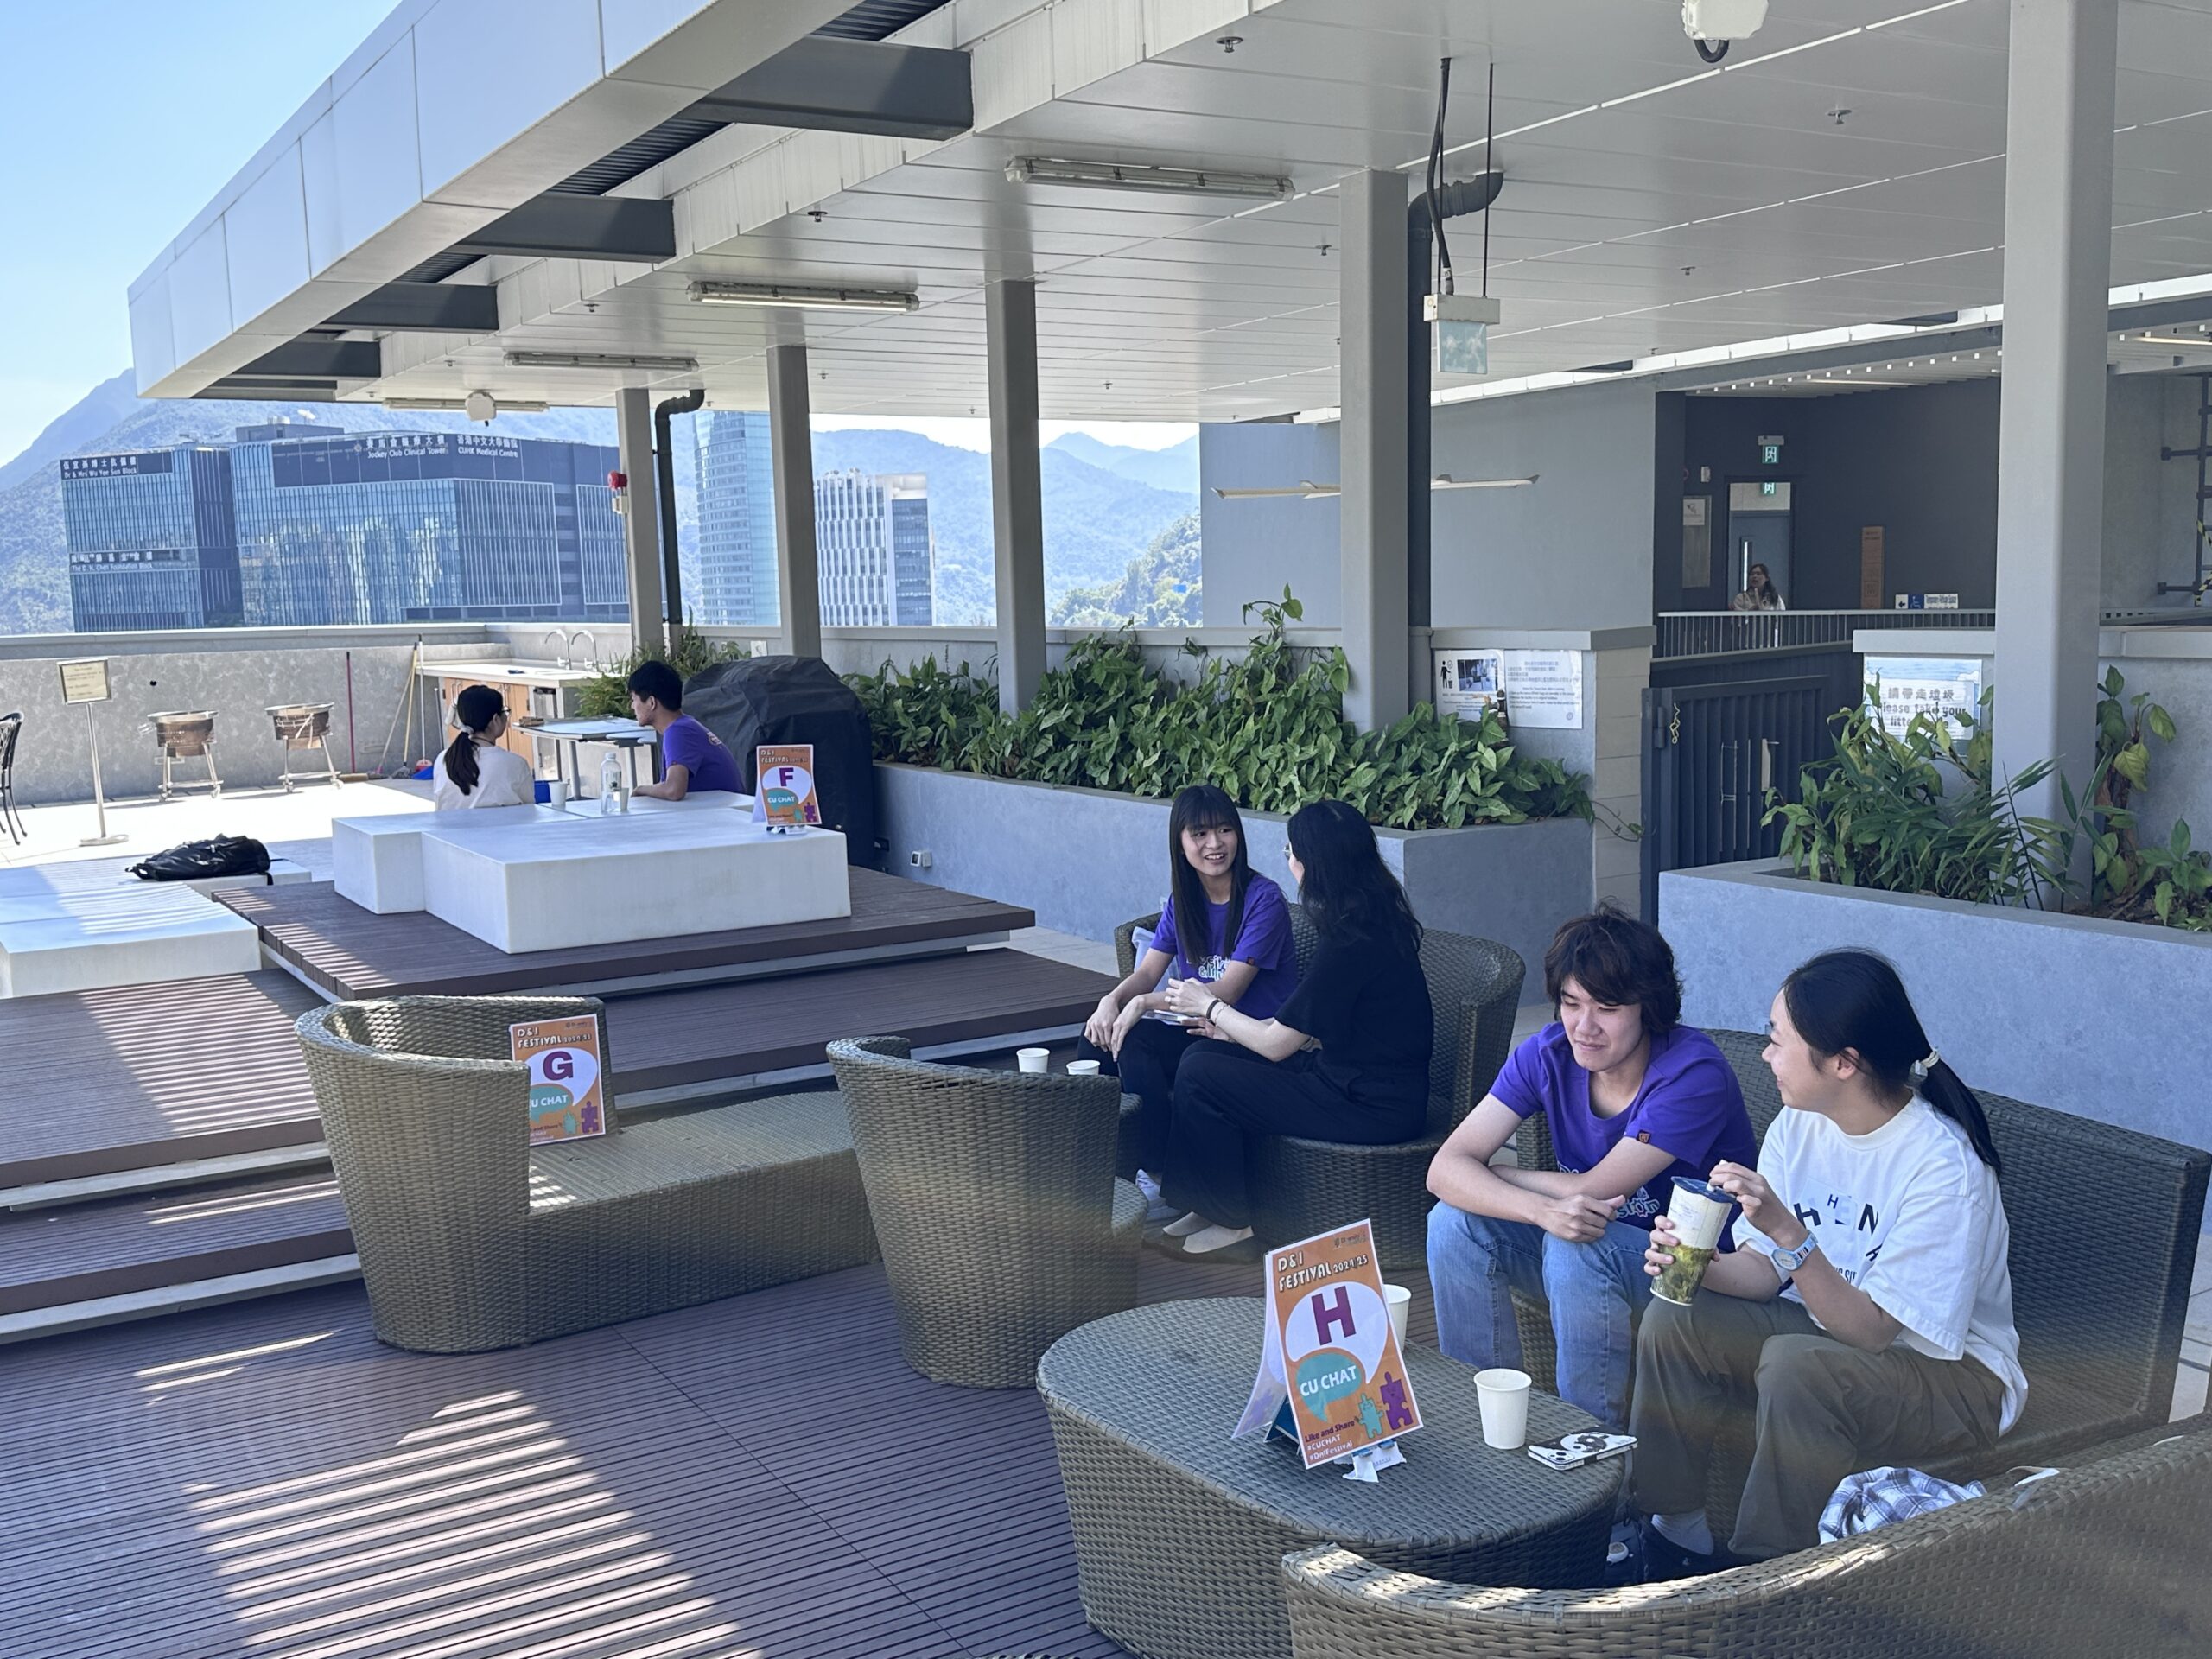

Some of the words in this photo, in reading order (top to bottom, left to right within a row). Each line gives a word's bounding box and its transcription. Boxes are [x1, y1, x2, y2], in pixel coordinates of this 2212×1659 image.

[368, 450, 388, 459] Jockey
[389, 448, 403, 457] Club
[404, 448, 426, 456] Clinical
[427, 447, 446, 455] Tower
[458, 446, 474, 455] CUHK
[476, 448, 499, 456] Medical
[499, 449, 518, 458] Centre
[1883, 702, 1910, 714] lease
[779, 767, 794, 787] F
[518, 1035, 562, 1048] FESTIVAL
[543, 1051, 574, 1081] G
[541, 1094, 568, 1106] CHAT
[1279, 1262, 1332, 1293] FESTIVAL
[1311, 1285, 1357, 1346] H
[1300, 1381, 1319, 1397] CU
[1320, 1365, 1357, 1389] CHAT
[1305, 1433, 1319, 1443] Like
[1321, 1427, 1333, 1437] and
[1334, 1420, 1355, 1433] Share
[1307, 1434, 1341, 1451] #CUCHAT
